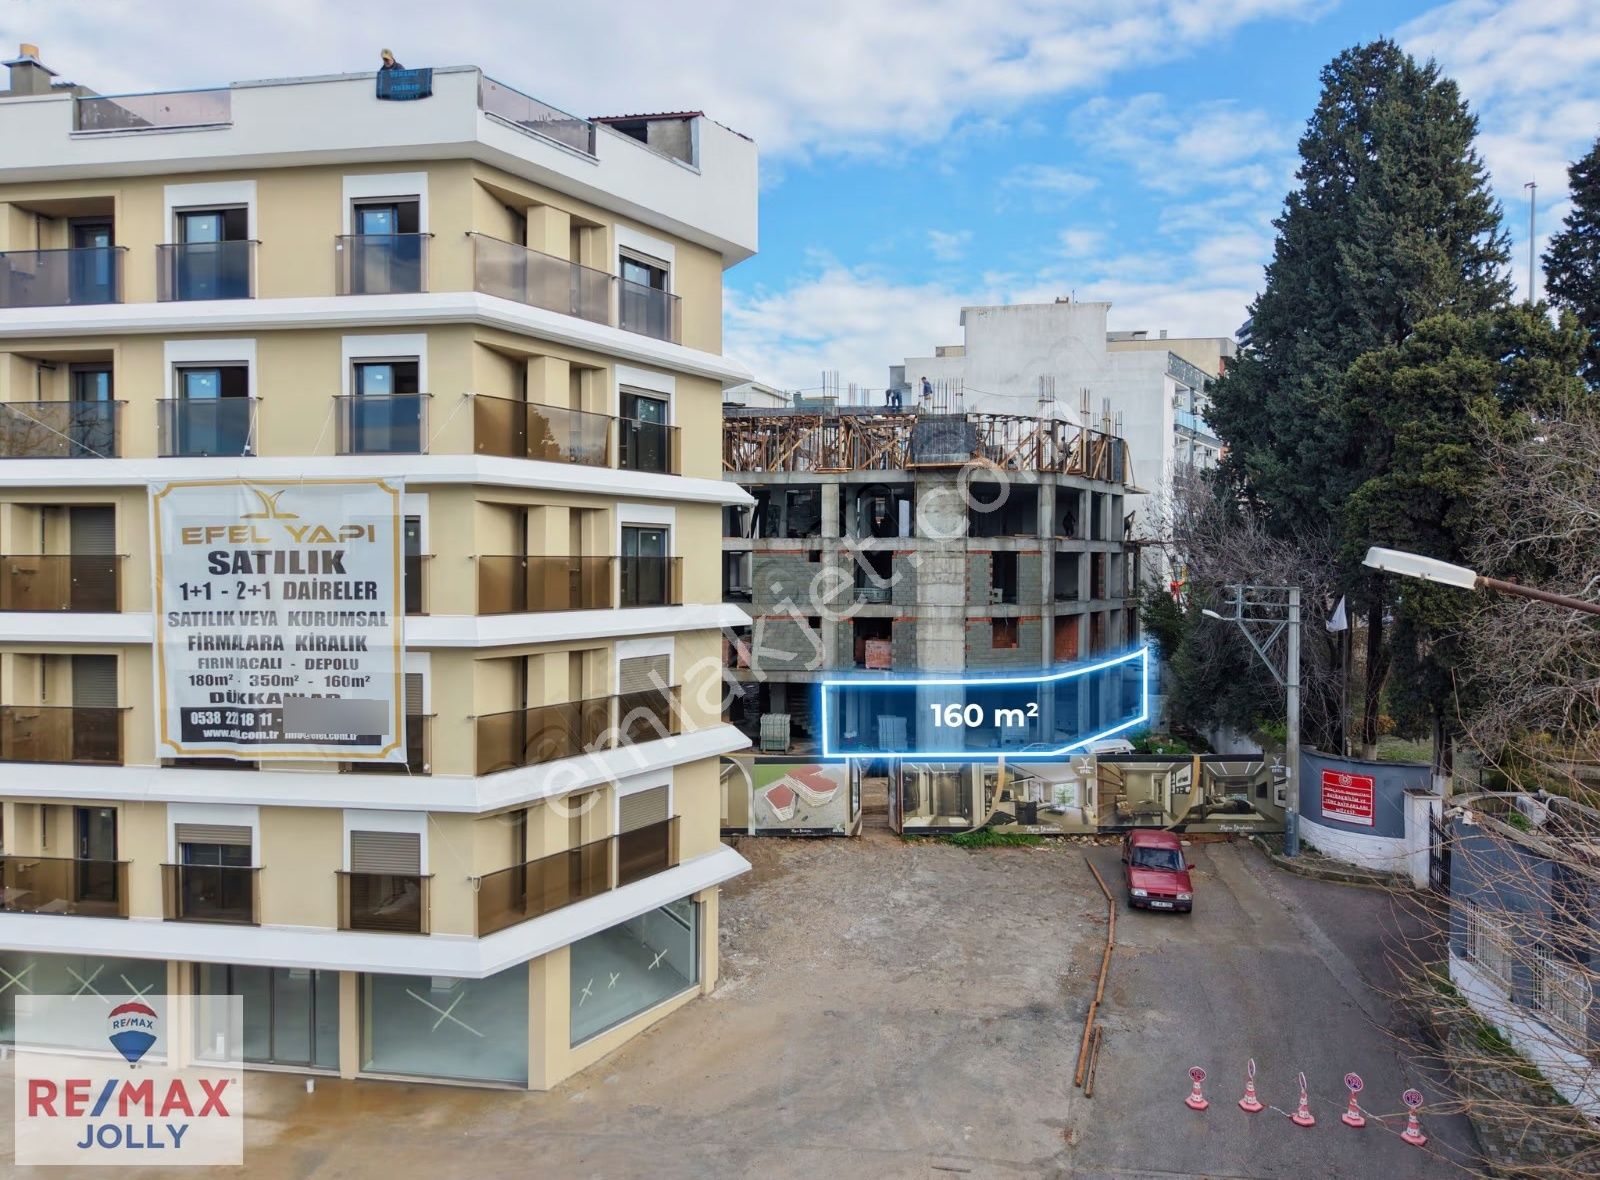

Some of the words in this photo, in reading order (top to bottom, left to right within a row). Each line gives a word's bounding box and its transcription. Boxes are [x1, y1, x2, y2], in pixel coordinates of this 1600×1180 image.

[182, 525, 272, 545] EFEL
[283, 525, 375, 543] YAPI
[208, 550, 347, 576] SATILIK
[179, 581, 212, 601] 1+1
[236, 580, 271, 600] 2+1
[283, 578, 378, 600] DAİRELER
[167, 611, 236, 627] SATILIK
[239, 610, 279, 627] VEYA
[287, 611, 389, 627] KURUMSAL
[295, 632, 368, 652] KİRALIK
[305, 658, 359, 671] DEPOLU
[249, 674, 300, 687] 350m²
[324, 675, 371, 688] 160m²
[209, 690, 341, 705] DÜKKA
[191, 711, 222, 726] 0538
[240, 713, 254, 727] 18
[260, 712, 272, 727] 11
